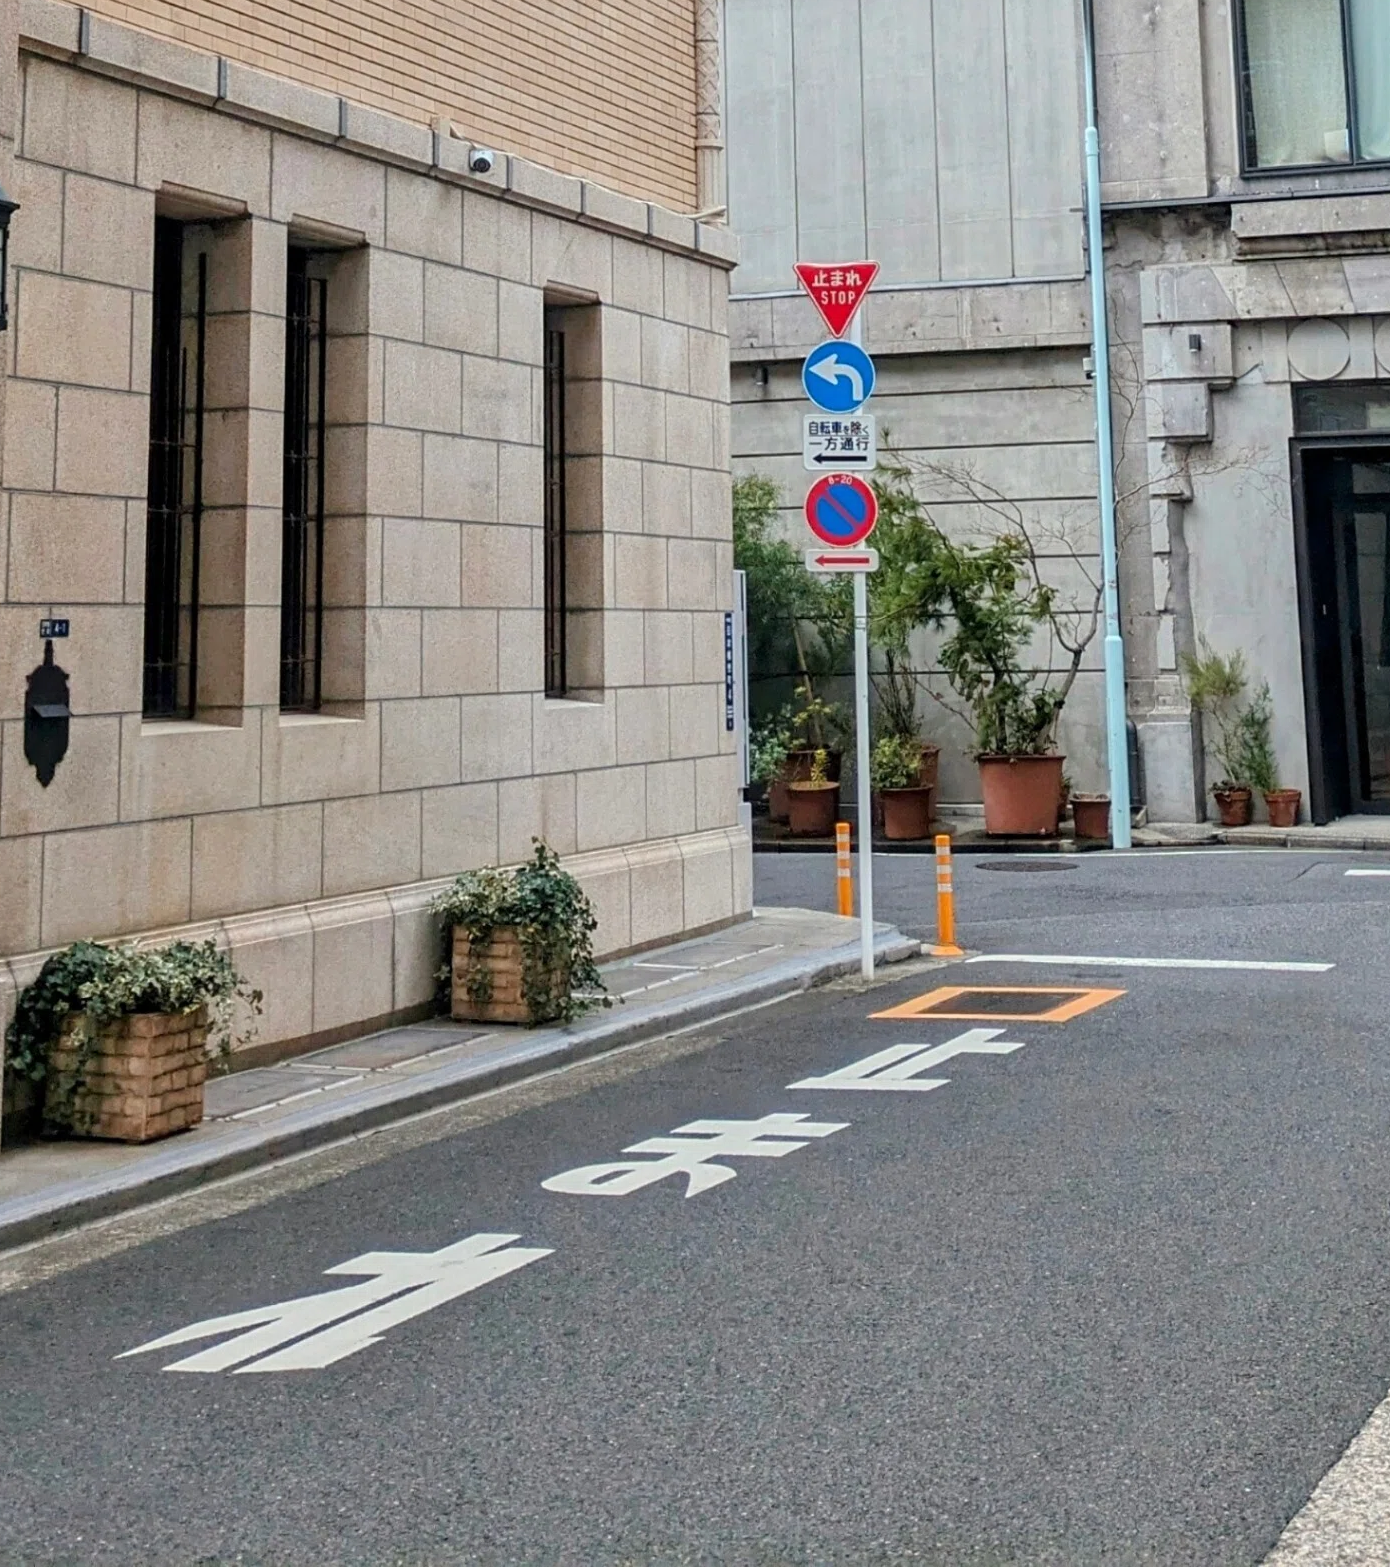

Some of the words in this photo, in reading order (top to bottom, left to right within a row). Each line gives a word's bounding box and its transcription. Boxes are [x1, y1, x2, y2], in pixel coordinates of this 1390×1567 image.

[812, 269, 863, 287] 止まれ
[821, 290, 856, 305] STOP
[809, 421, 869, 435] 自転車を除く
[809, 437, 870, 451] 一方通行
[827, 475, 853, 485] 8-20
[113, 1028, 1026, 1374] 止まれ
